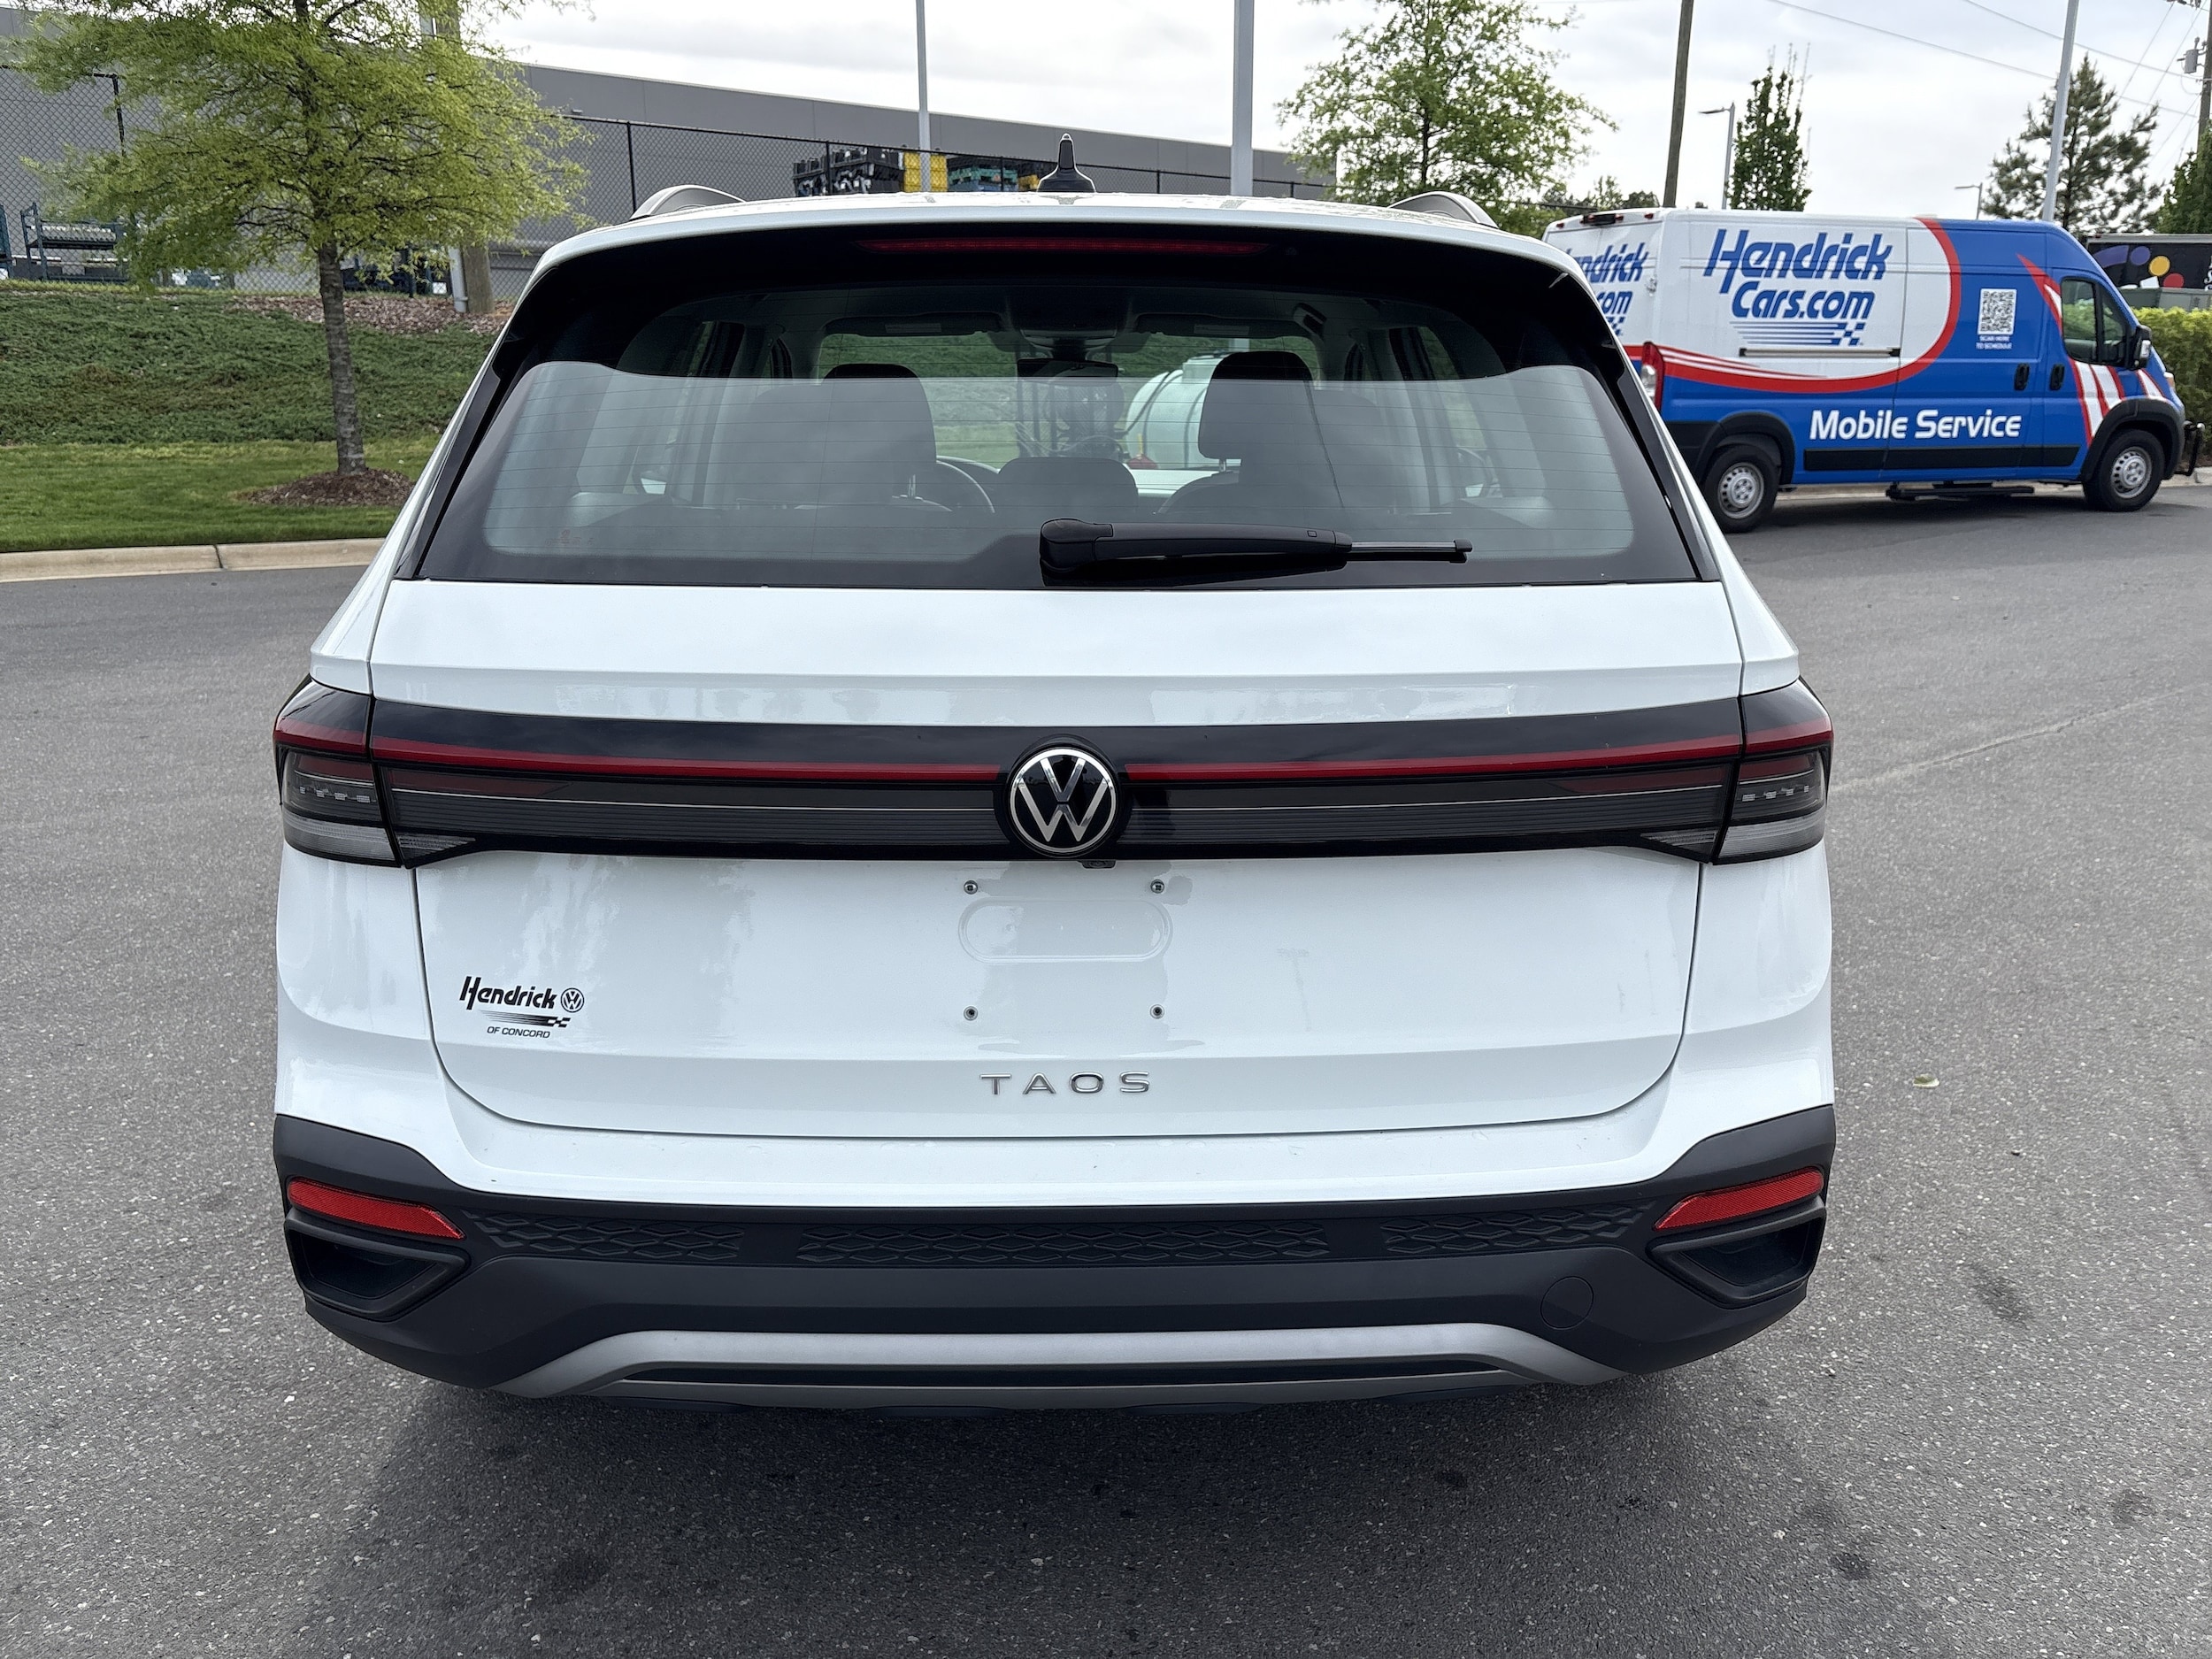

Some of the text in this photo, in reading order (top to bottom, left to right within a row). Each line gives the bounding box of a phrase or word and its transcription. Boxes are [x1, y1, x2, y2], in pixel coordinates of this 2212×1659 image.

[1566, 242, 1648, 283] ndrick
[1703, 228, 1893, 294] Hendrick
[1732, 280, 1875, 319] Cars.com
[1809, 409, 2022, 440] Mobile Service
[459, 976, 557, 1010] Hendrick
[502, 1027, 550, 1039] CONCORD
[979, 1071, 1150, 1095] TAOS
